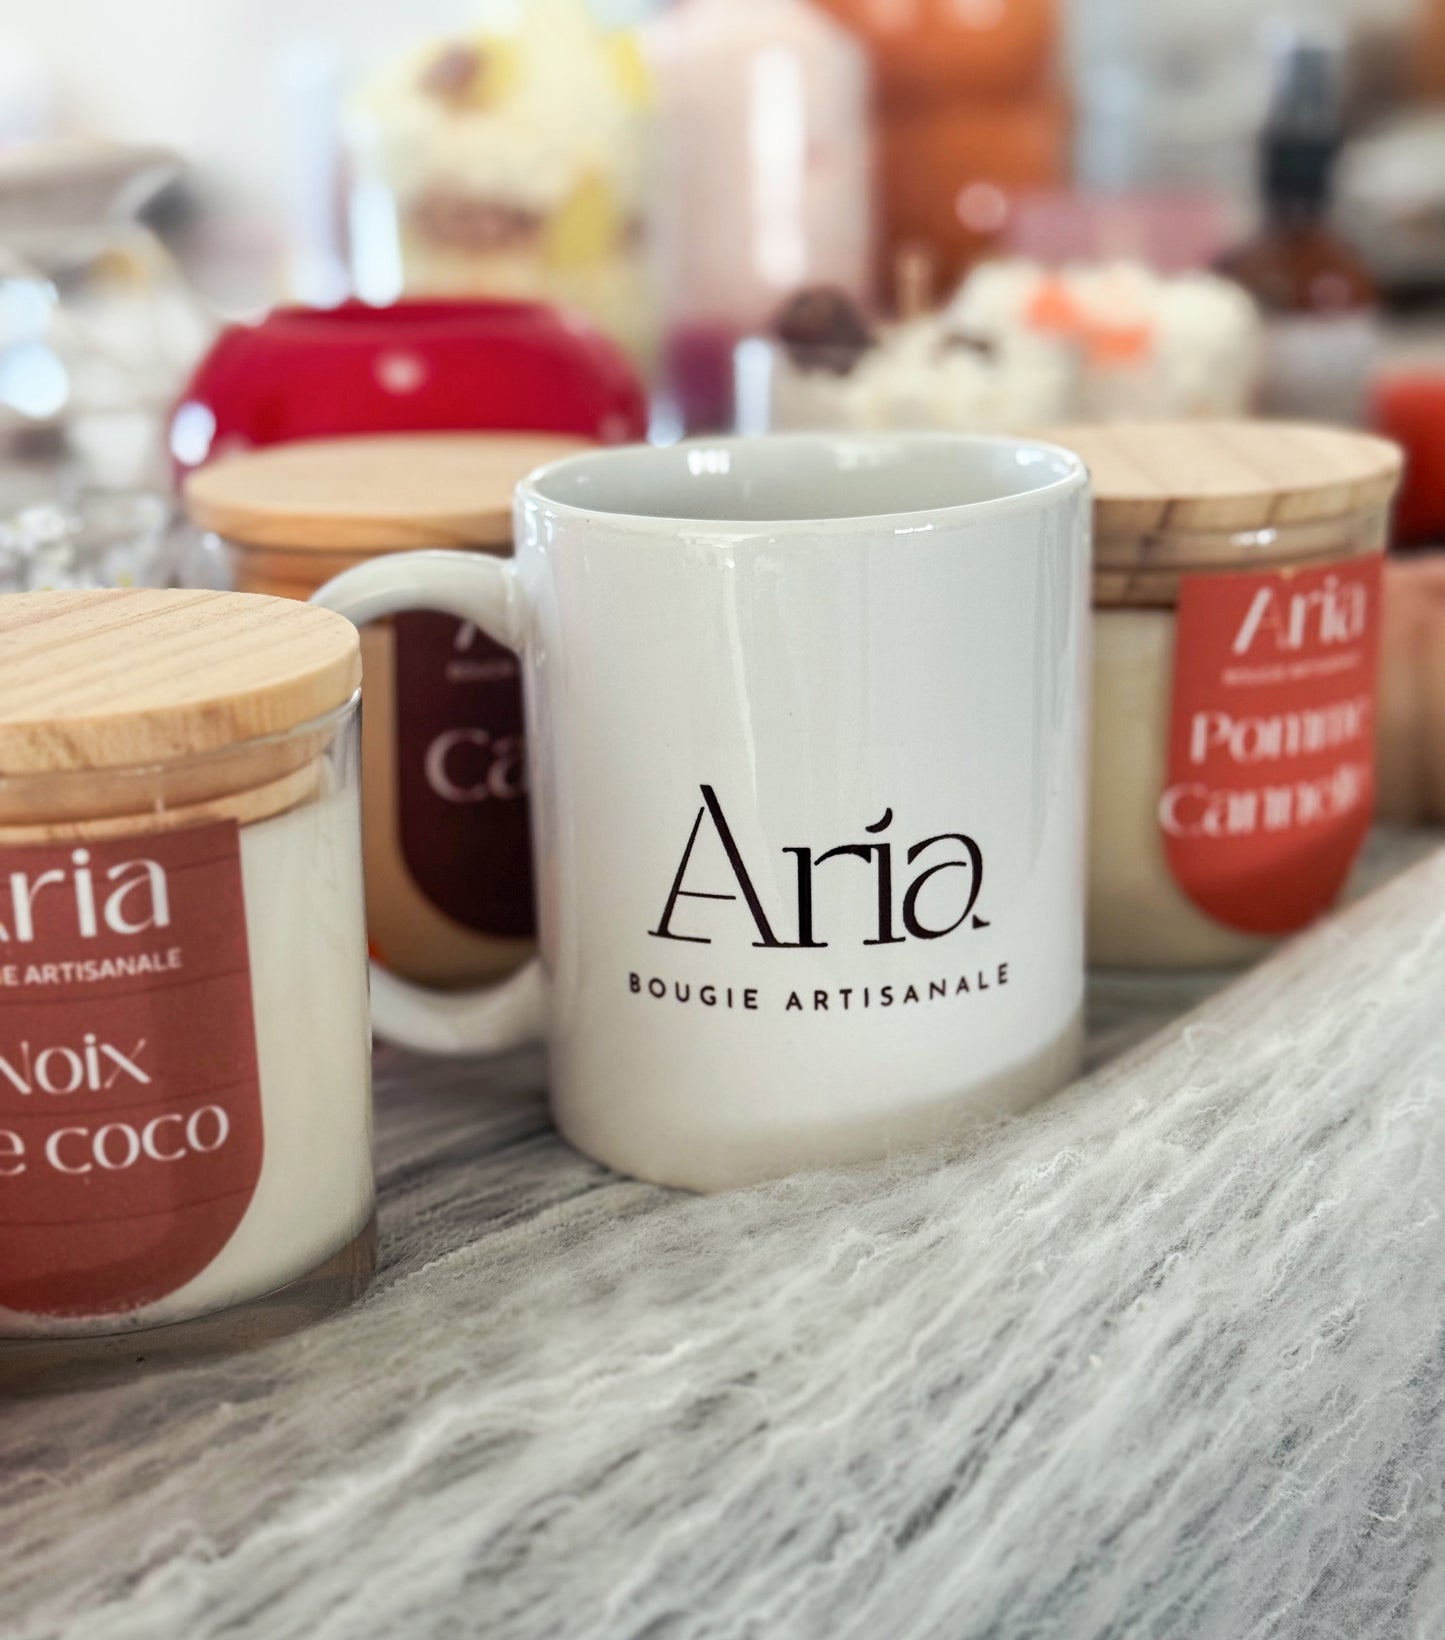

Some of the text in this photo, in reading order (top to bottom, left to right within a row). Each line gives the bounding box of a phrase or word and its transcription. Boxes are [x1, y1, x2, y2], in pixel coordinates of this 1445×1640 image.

[1232, 575, 1368, 655] Aria
[1188, 697, 1371, 764] Pomm
[0, 848, 170, 943] ria
[24, 948, 183, 986] ARTISANALE
[629, 962, 1010, 1011] BOUGIE ARTISANALE
[0, 1032, 152, 1095] Noix
[0, 1104, 230, 1177] e coco
